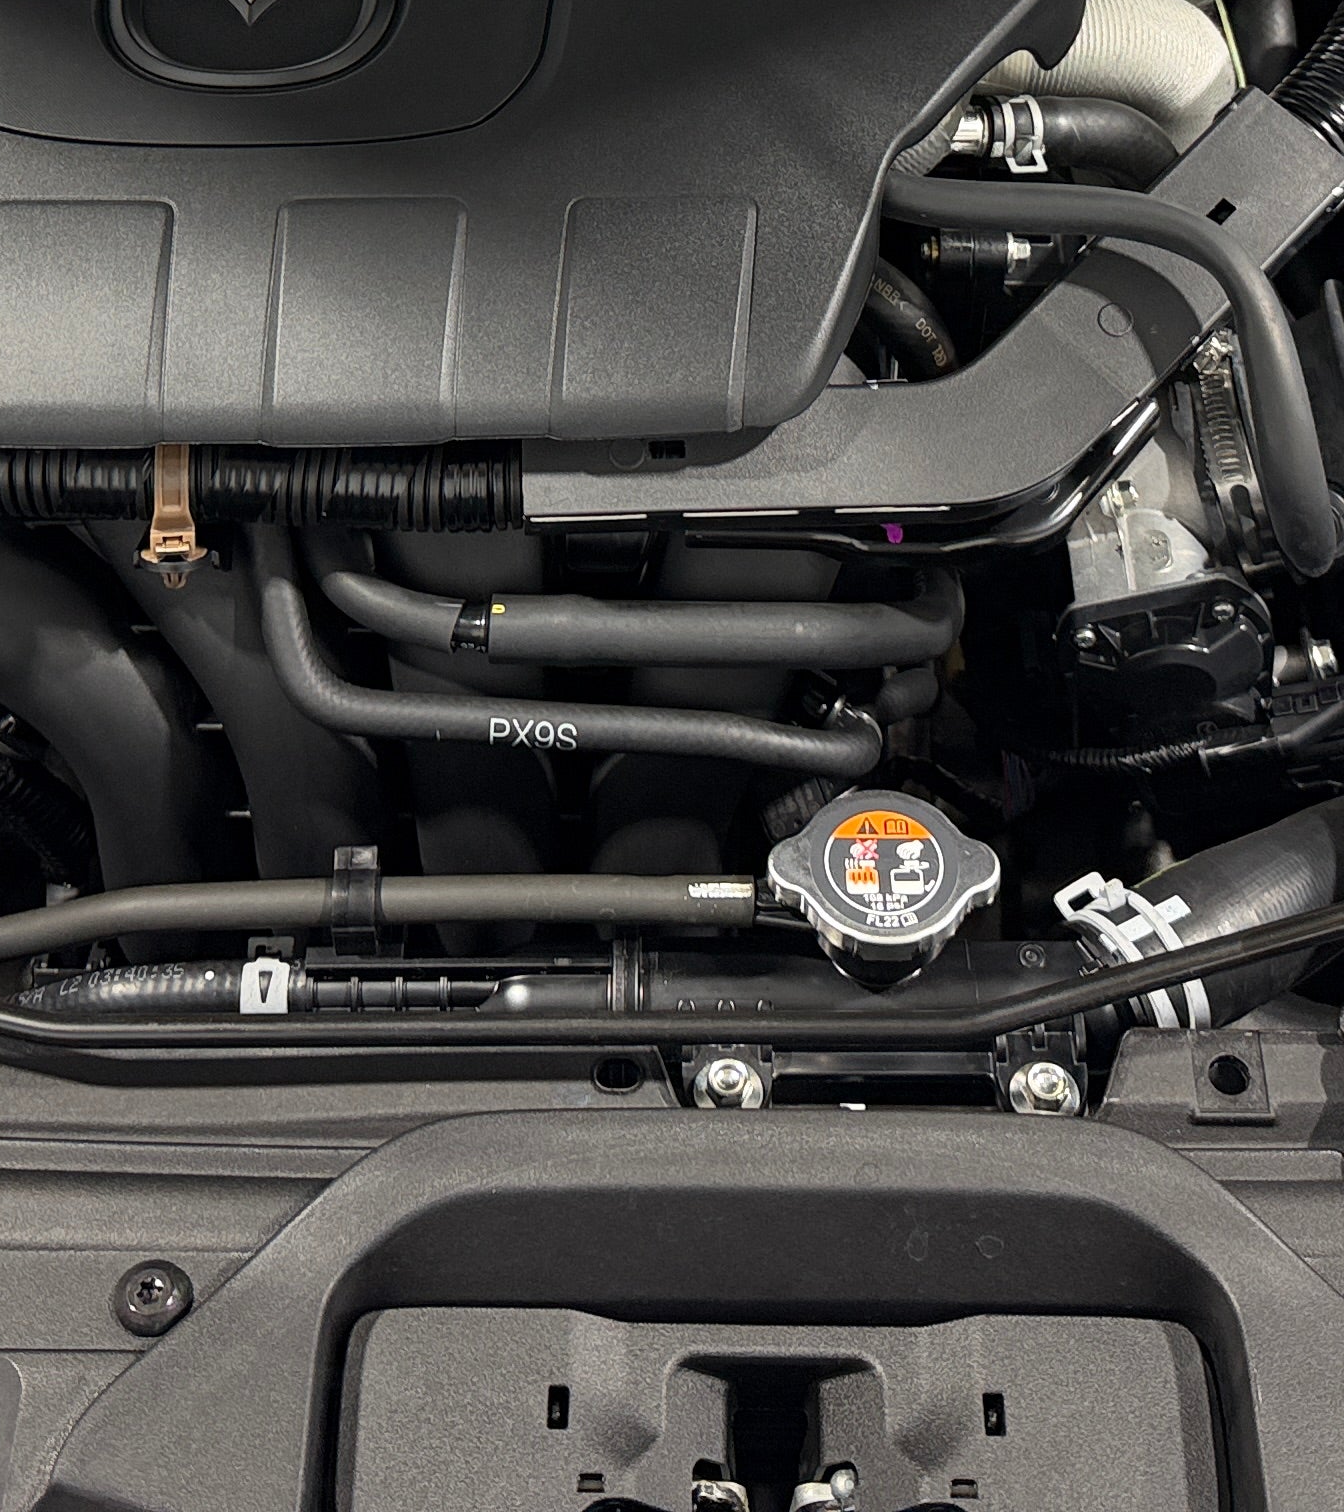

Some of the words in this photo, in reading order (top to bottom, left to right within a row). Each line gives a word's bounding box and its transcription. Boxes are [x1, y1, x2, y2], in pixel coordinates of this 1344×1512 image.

[915, 317, 937, 343] DOT
[489, 717, 578, 751] PX9S
[866, 913, 901, 928] FL22
